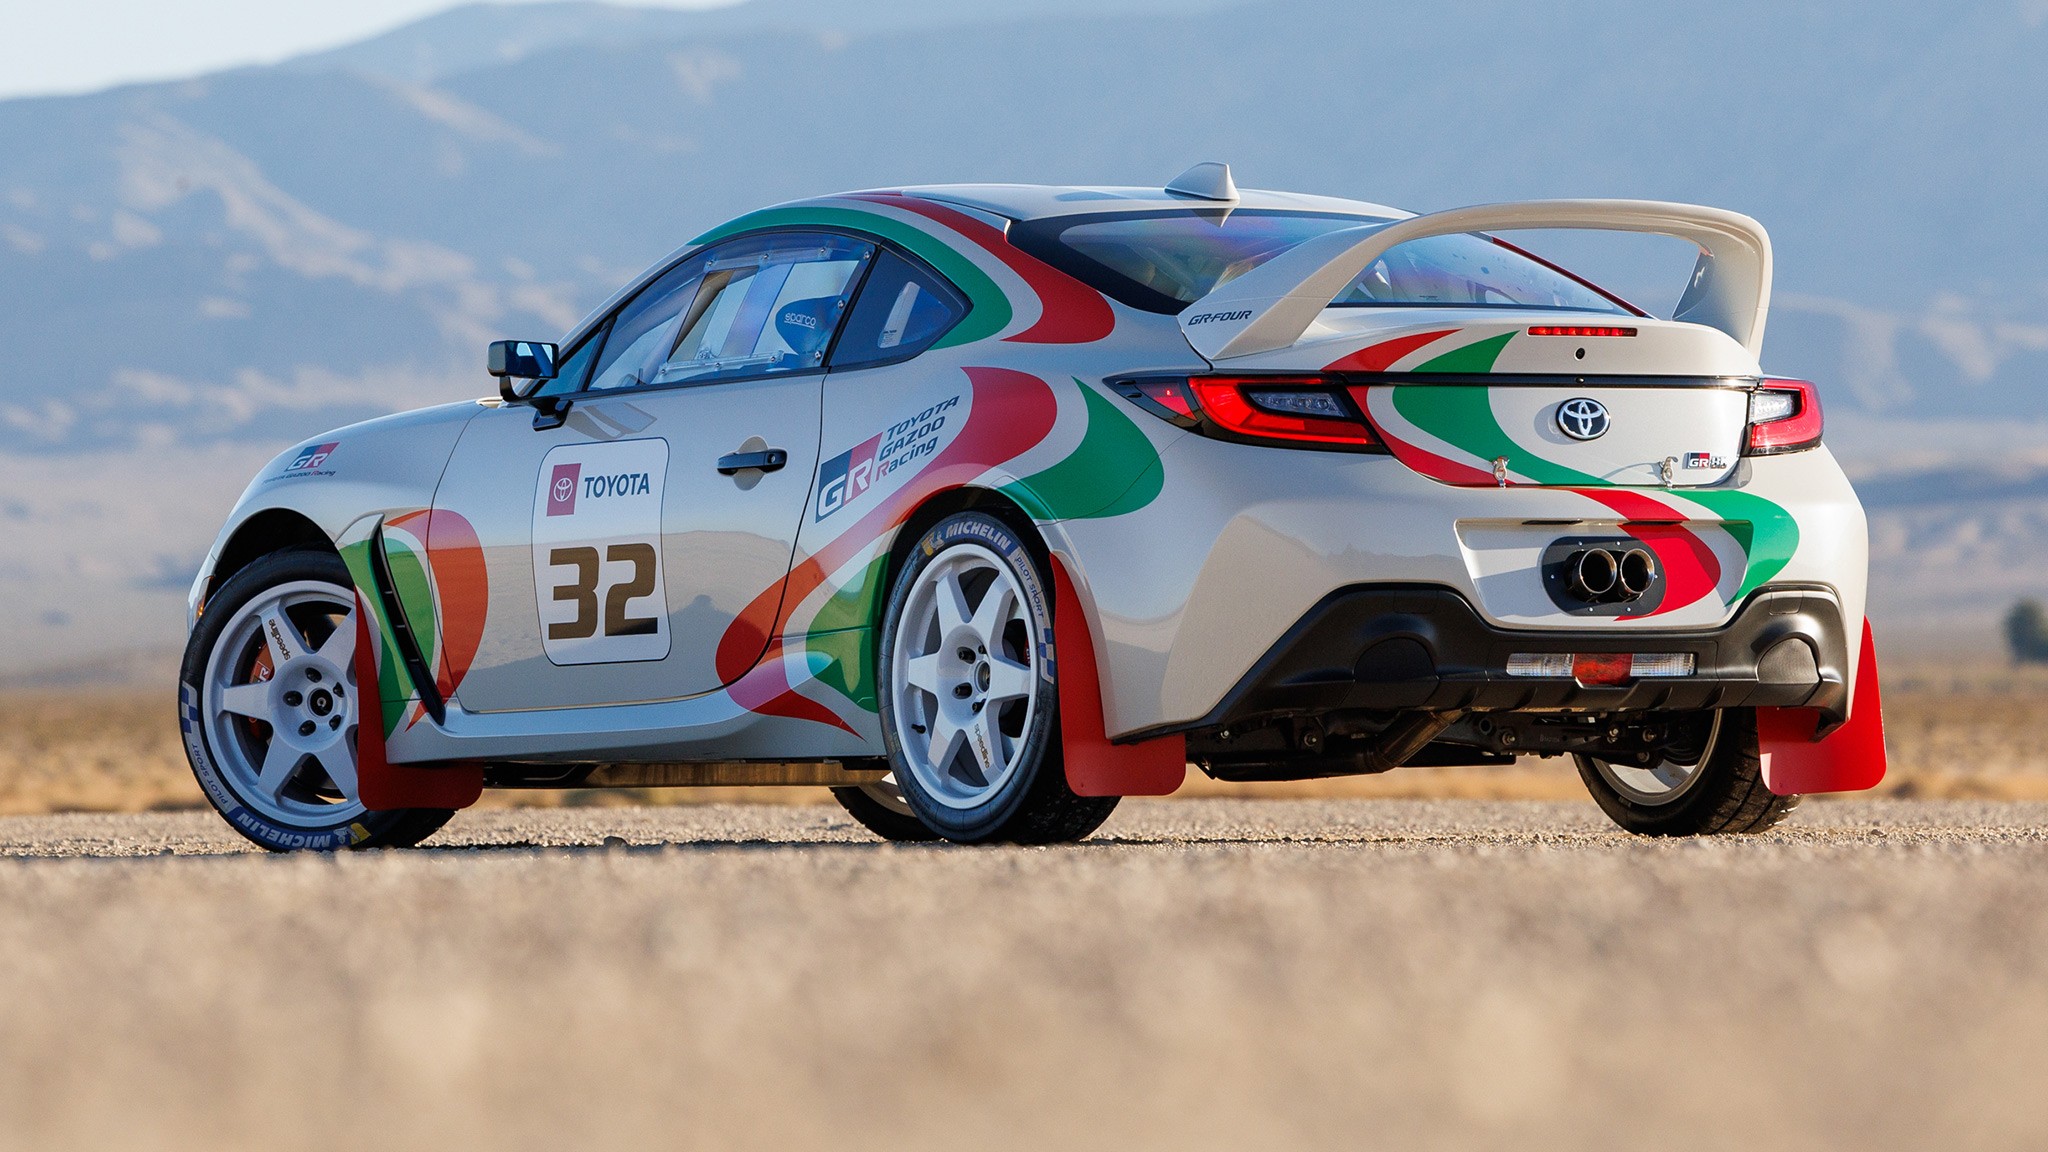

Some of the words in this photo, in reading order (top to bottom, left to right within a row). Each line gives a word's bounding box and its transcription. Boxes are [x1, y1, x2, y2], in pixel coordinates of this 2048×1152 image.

[784, 312, 816, 327] sparco
[879, 416, 946, 461] GAZOO
[887, 395, 960, 440] TOYOTA
[286, 453, 329, 471] GR
[875, 436, 939, 482] Racing
[584, 473, 650, 498] TOYOTA
[818, 458, 873, 517] GR
[945, 521, 1012, 551] MICHELIN
[549, 543, 658, 640] 32
[1016, 555, 1033, 582] PILOT
[1029, 584, 1044, 618] SPORT
[268, 618, 290, 660] speedline
[192, 743, 208, 780] SPORT
[974, 723, 990, 769] speedline
[207, 779, 227, 804] PILOT
[237, 812, 331, 848] MICHELIN
